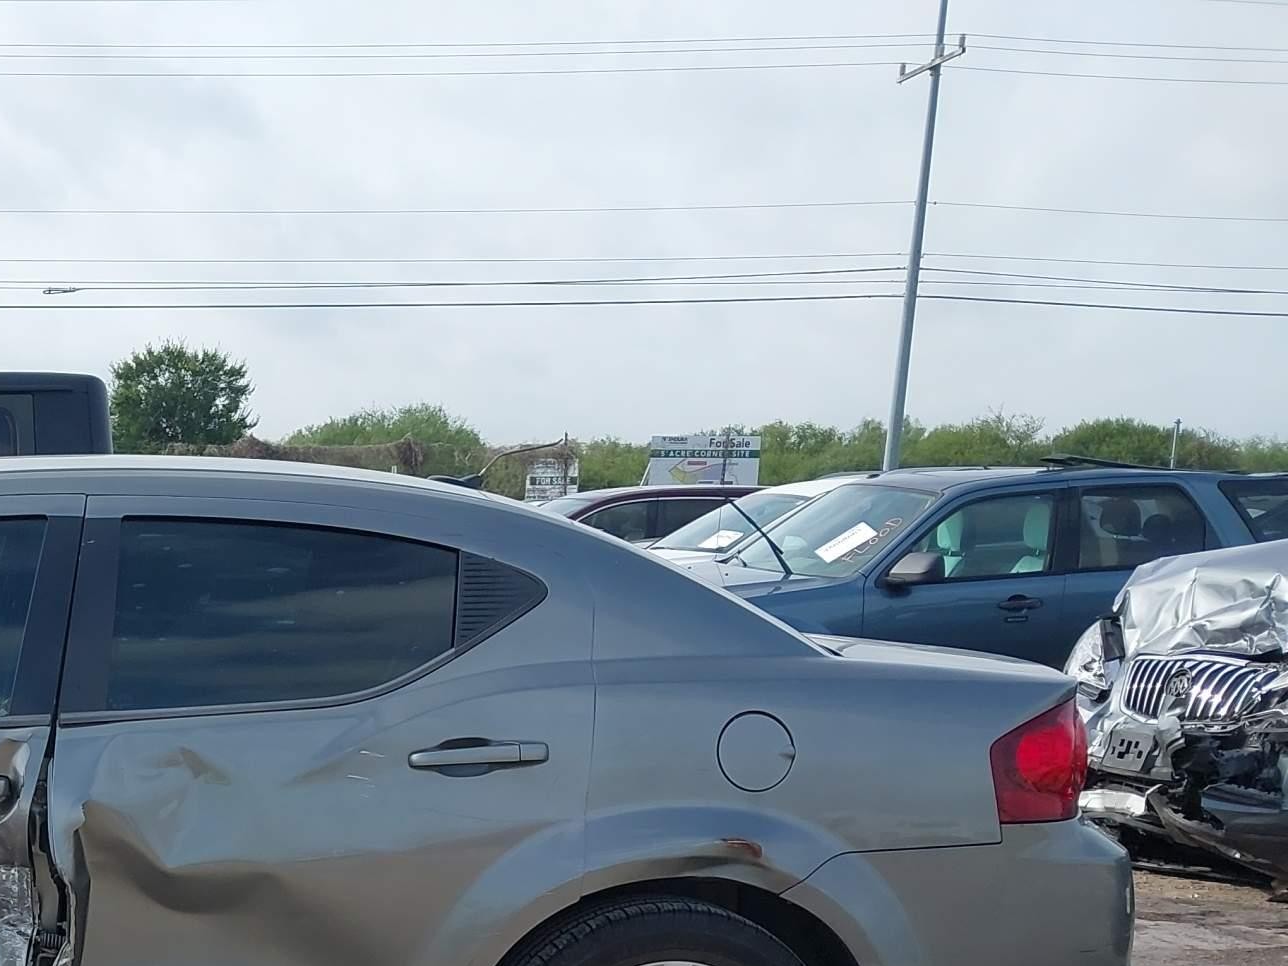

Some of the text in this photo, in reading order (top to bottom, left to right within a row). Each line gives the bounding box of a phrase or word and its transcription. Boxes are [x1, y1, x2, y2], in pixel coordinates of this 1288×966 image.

[730, 438, 751, 448] Sale
[552, 477, 572, 485] SAE
[841, 517, 903, 563] FLOOD
